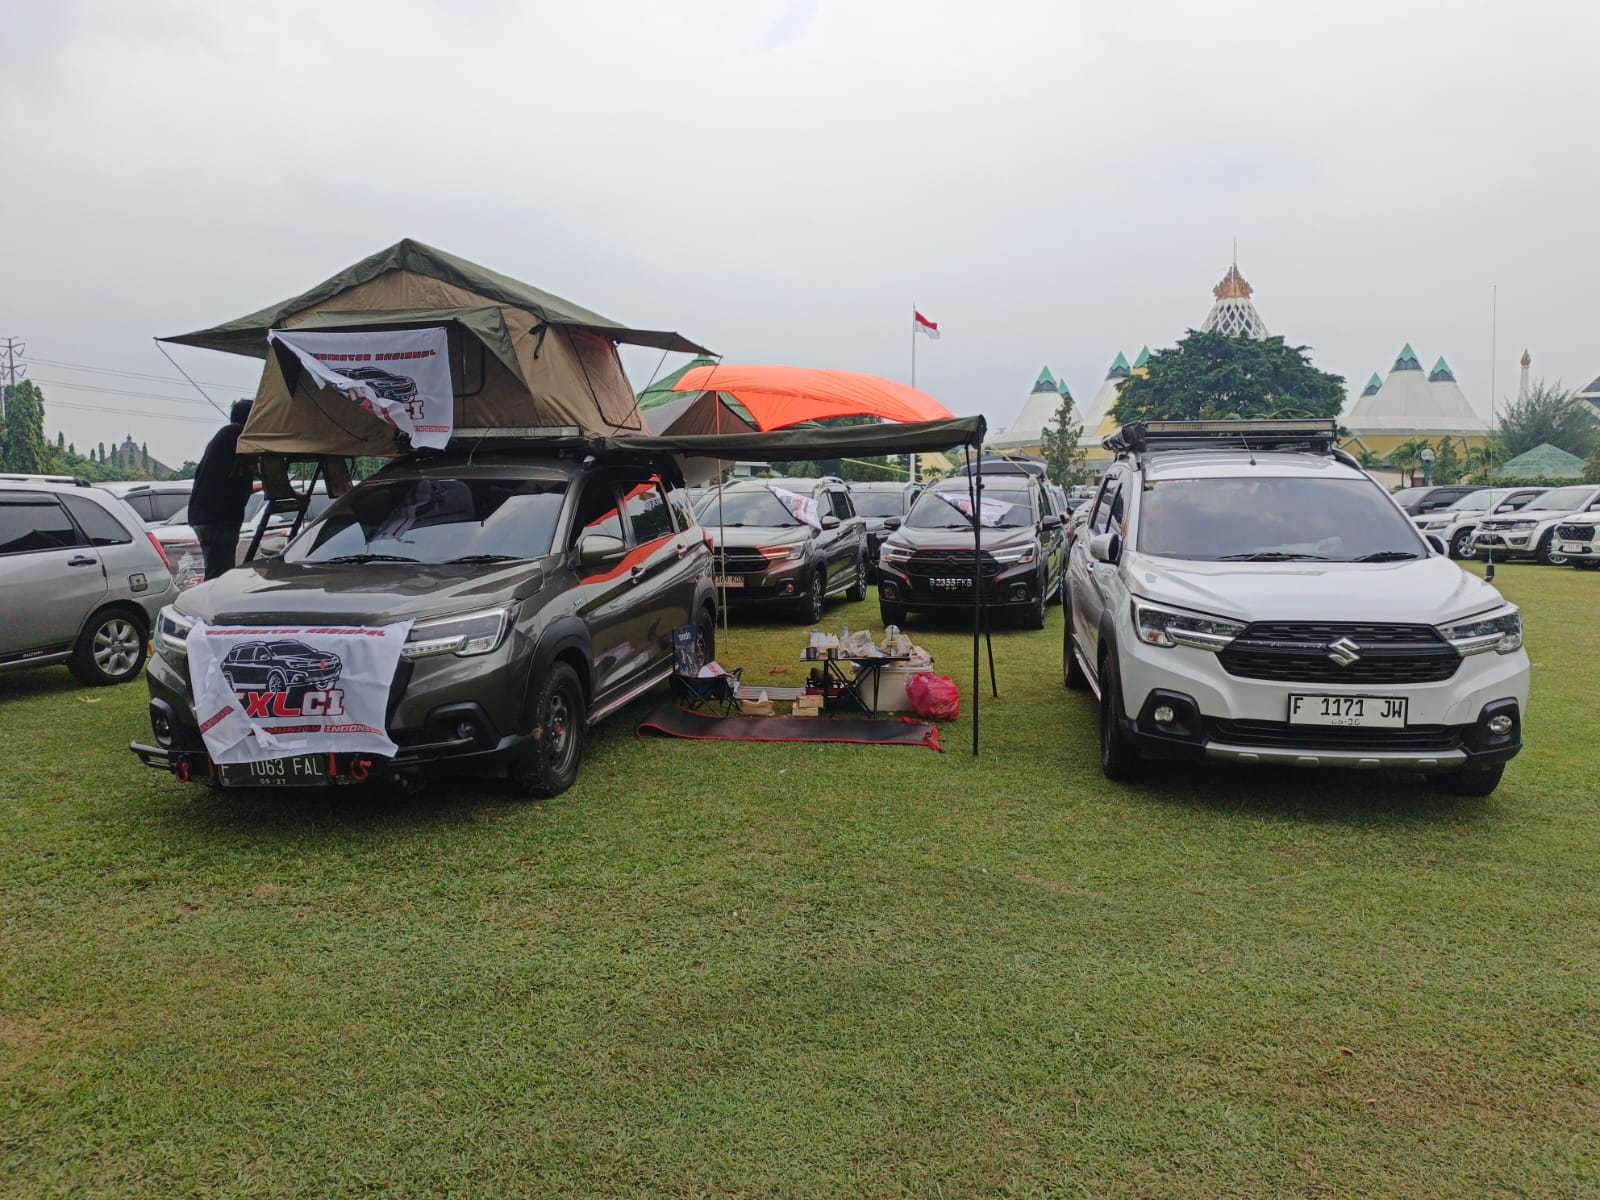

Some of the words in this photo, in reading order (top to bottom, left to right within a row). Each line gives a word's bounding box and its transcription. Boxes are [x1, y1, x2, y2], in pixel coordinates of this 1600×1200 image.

[1293, 697, 1304, 715] F
[1321, 698, 1364, 716] 1171
[1380, 700, 1402, 718] JW
[220, 763, 229, 776] F
[249, 759, 285, 776] 1063
[293, 757, 323, 776] FAL
